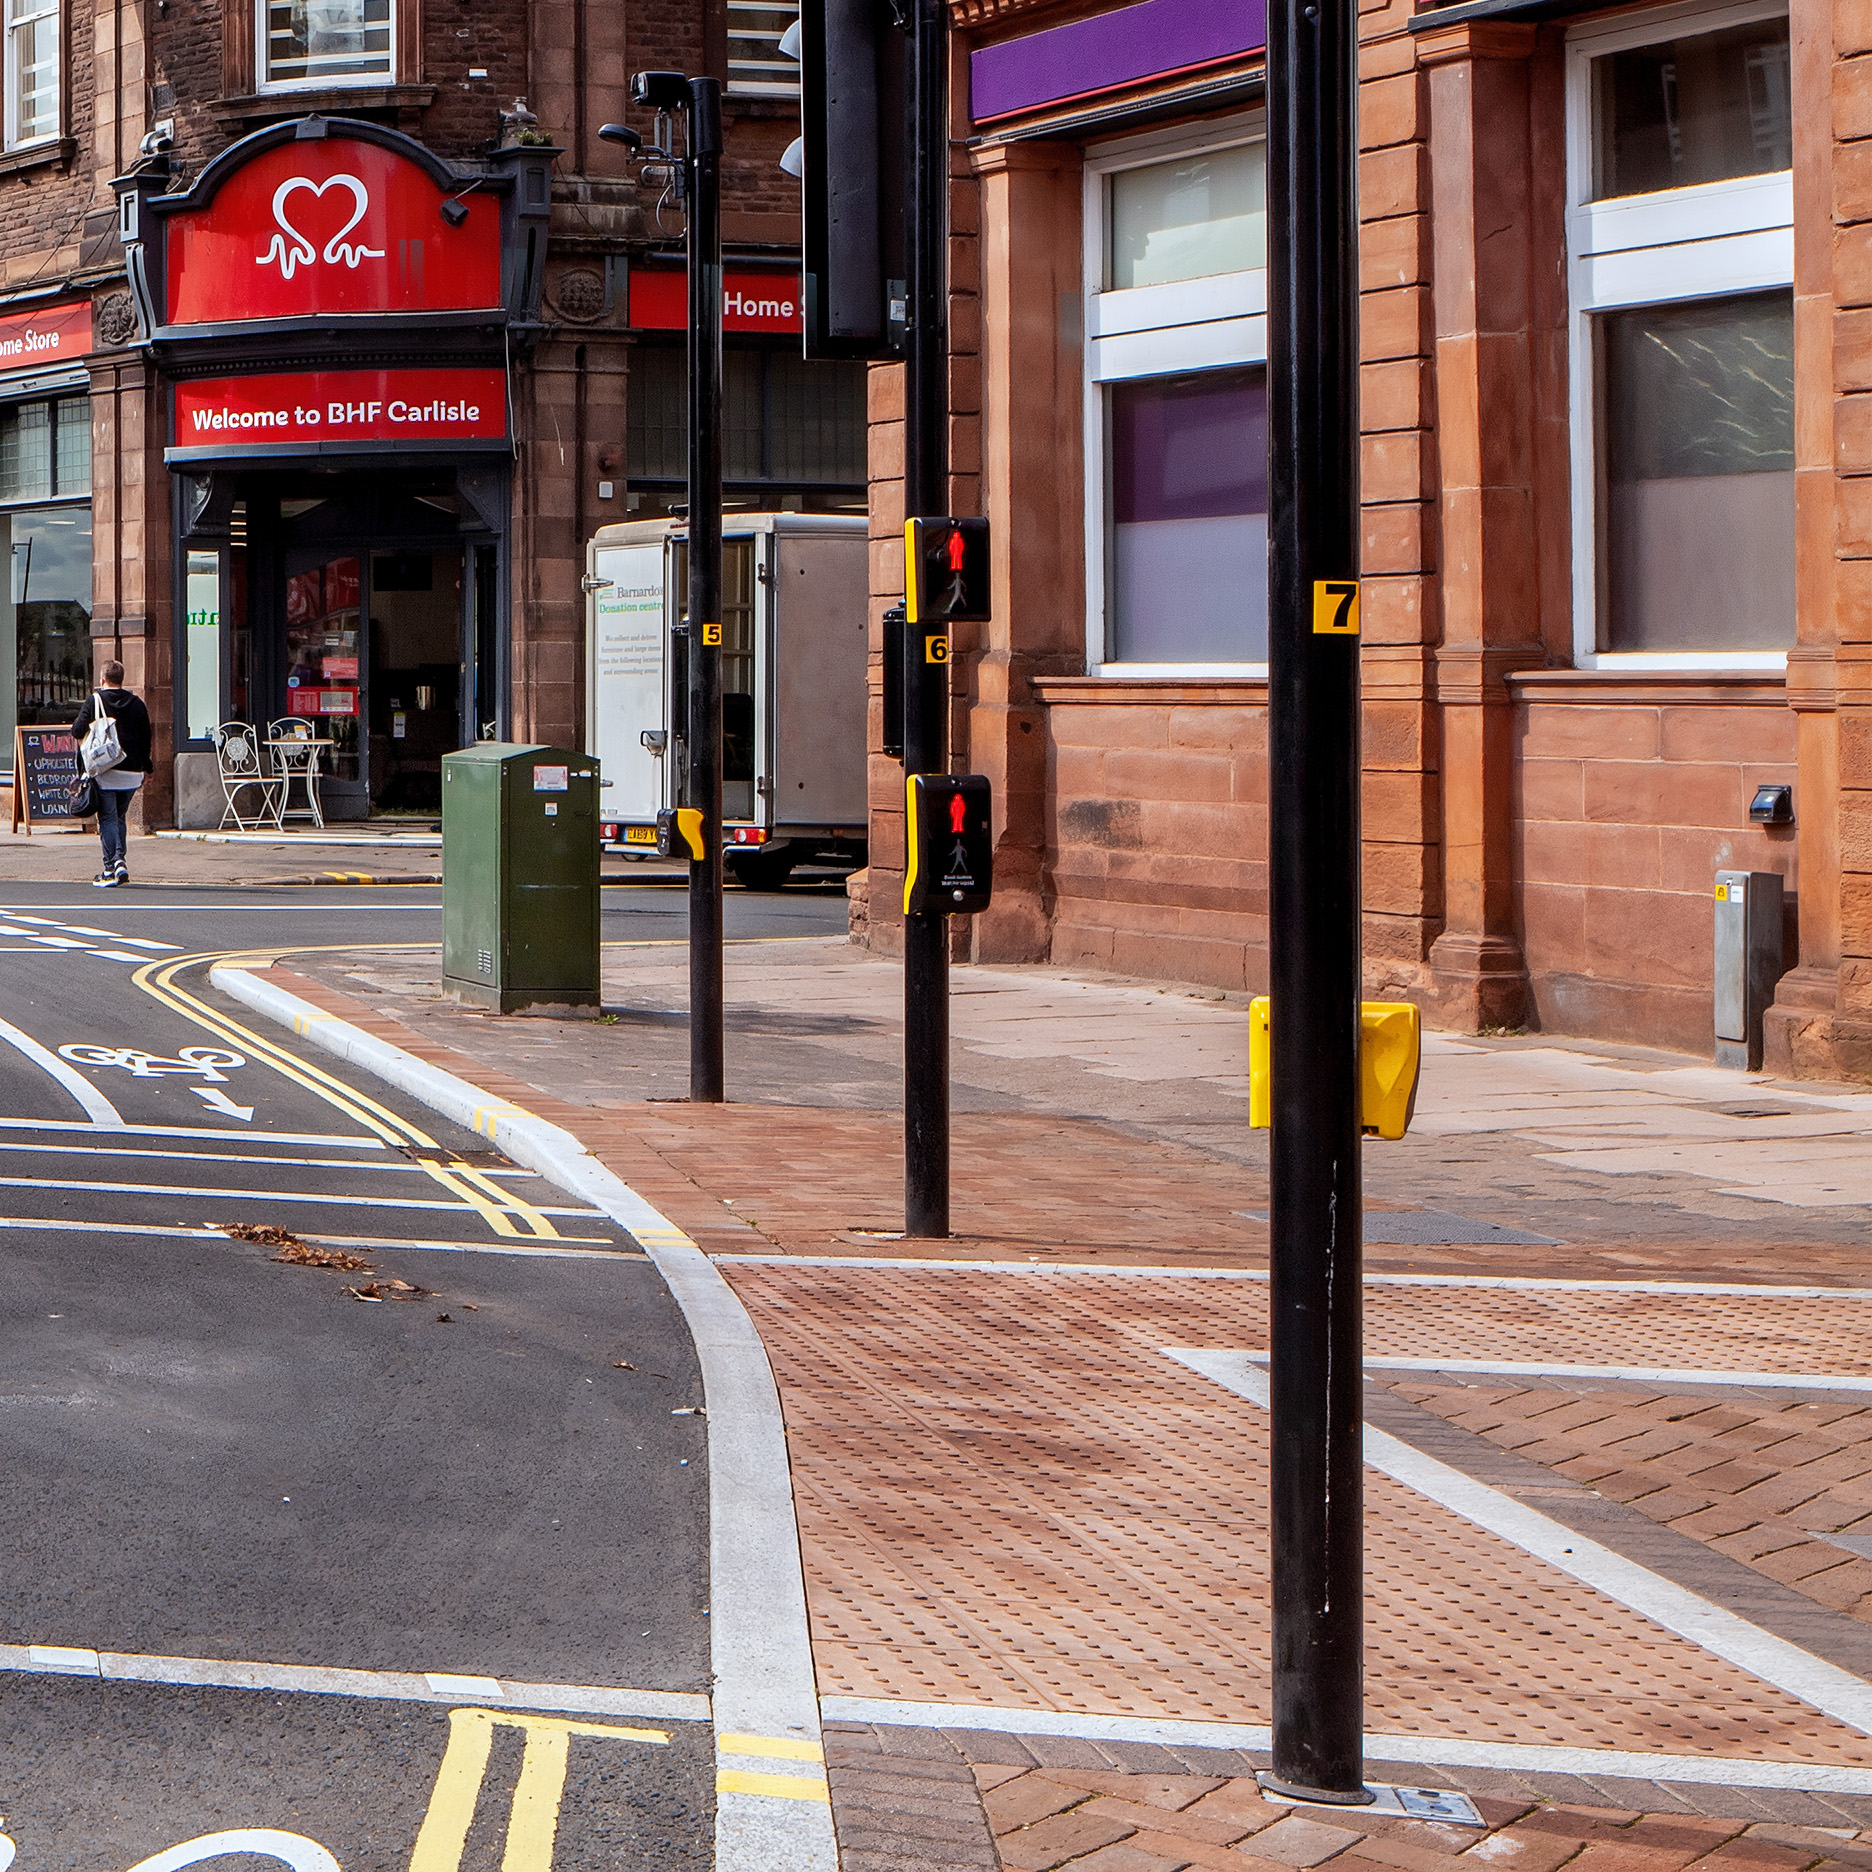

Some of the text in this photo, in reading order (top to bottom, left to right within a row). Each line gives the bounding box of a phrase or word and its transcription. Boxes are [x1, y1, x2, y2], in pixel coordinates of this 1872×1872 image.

[724, 291, 794, 317] Home
[24, 329, 59, 352] Store
[192, 400, 480, 431] Welcome to BHF Carlisle
[599, 603, 637, 614] Donation
[1324, 584, 1358, 627] 7
[707, 625, 720, 643] 5
[931, 638, 948, 661] 6
[34, 758, 78, 770] UPHOLSTE
[38, 787, 61, 800] WHITE
